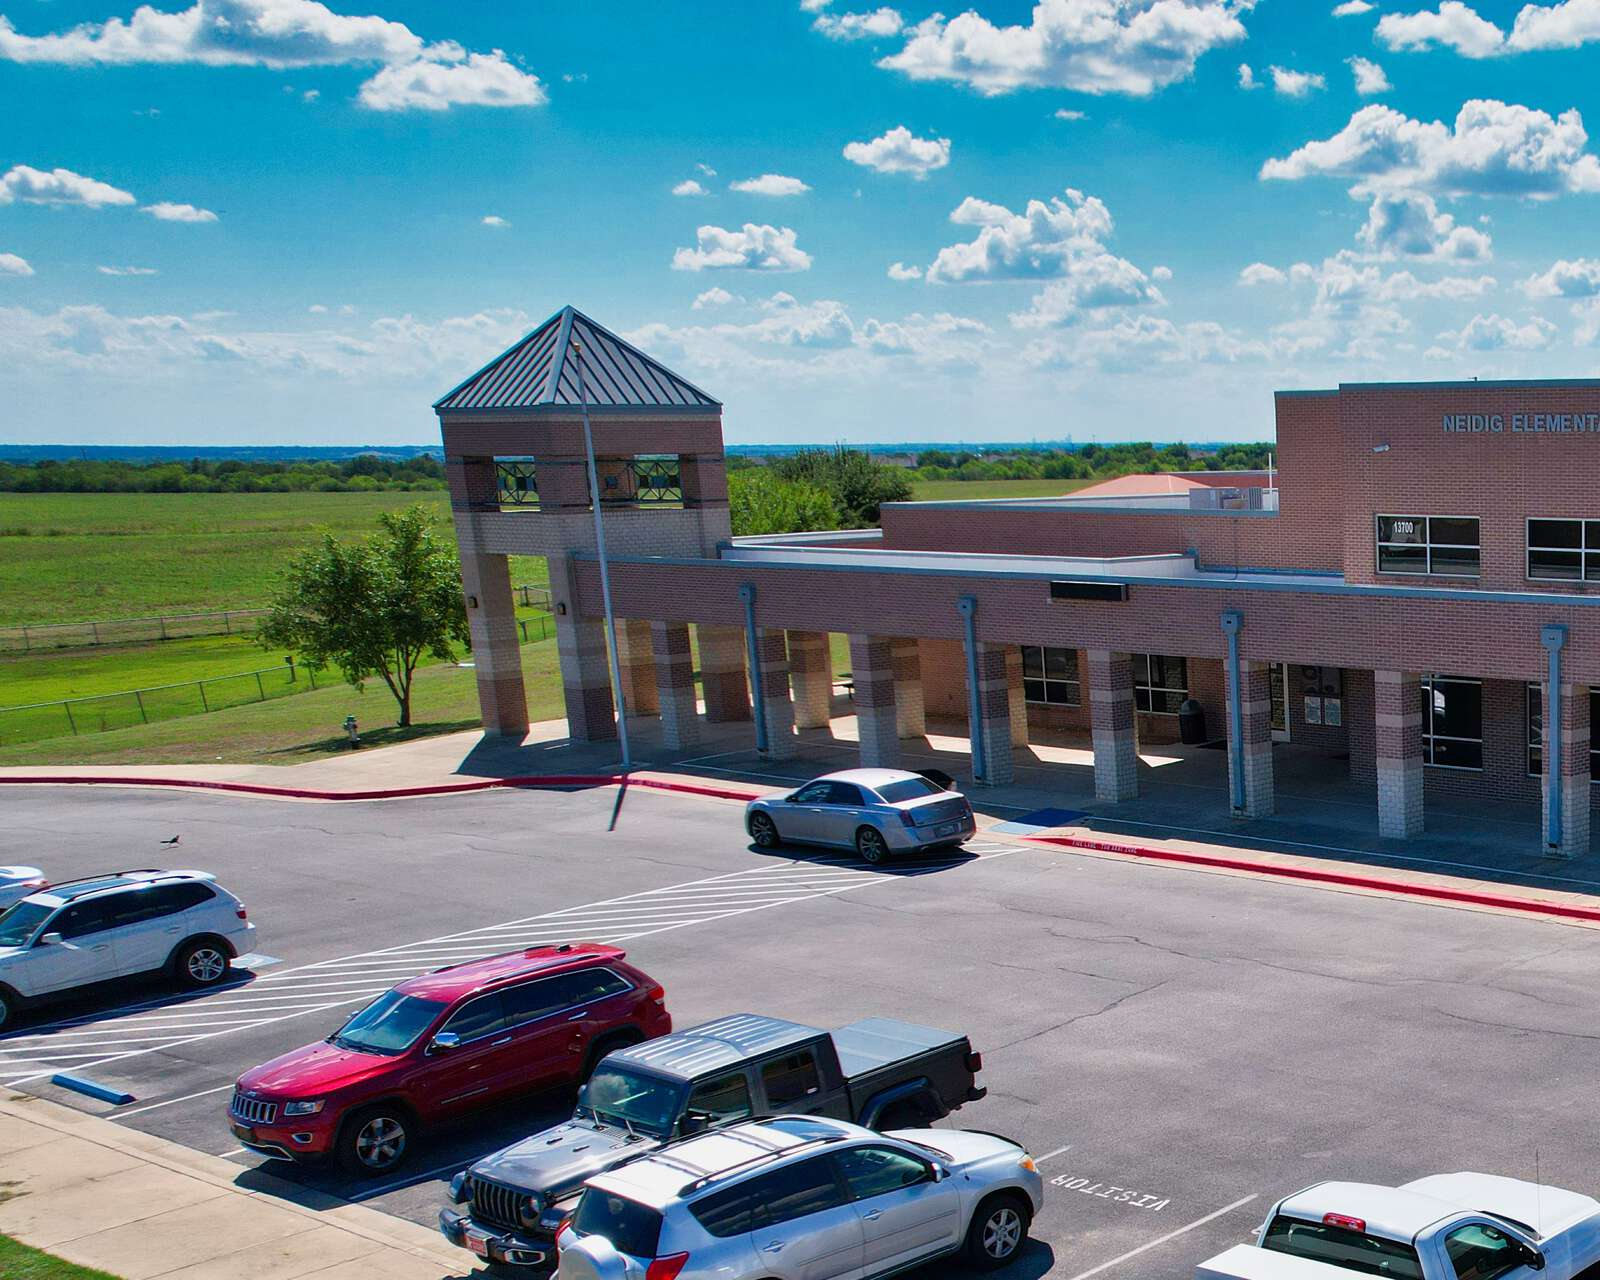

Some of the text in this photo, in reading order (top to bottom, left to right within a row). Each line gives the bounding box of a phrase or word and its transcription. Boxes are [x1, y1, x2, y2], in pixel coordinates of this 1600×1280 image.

[1443, 414, 1503, 432] NEIDIG
[1394, 521, 1414, 533] 13700
[1049, 1174, 1171, 1211] VISITOR
